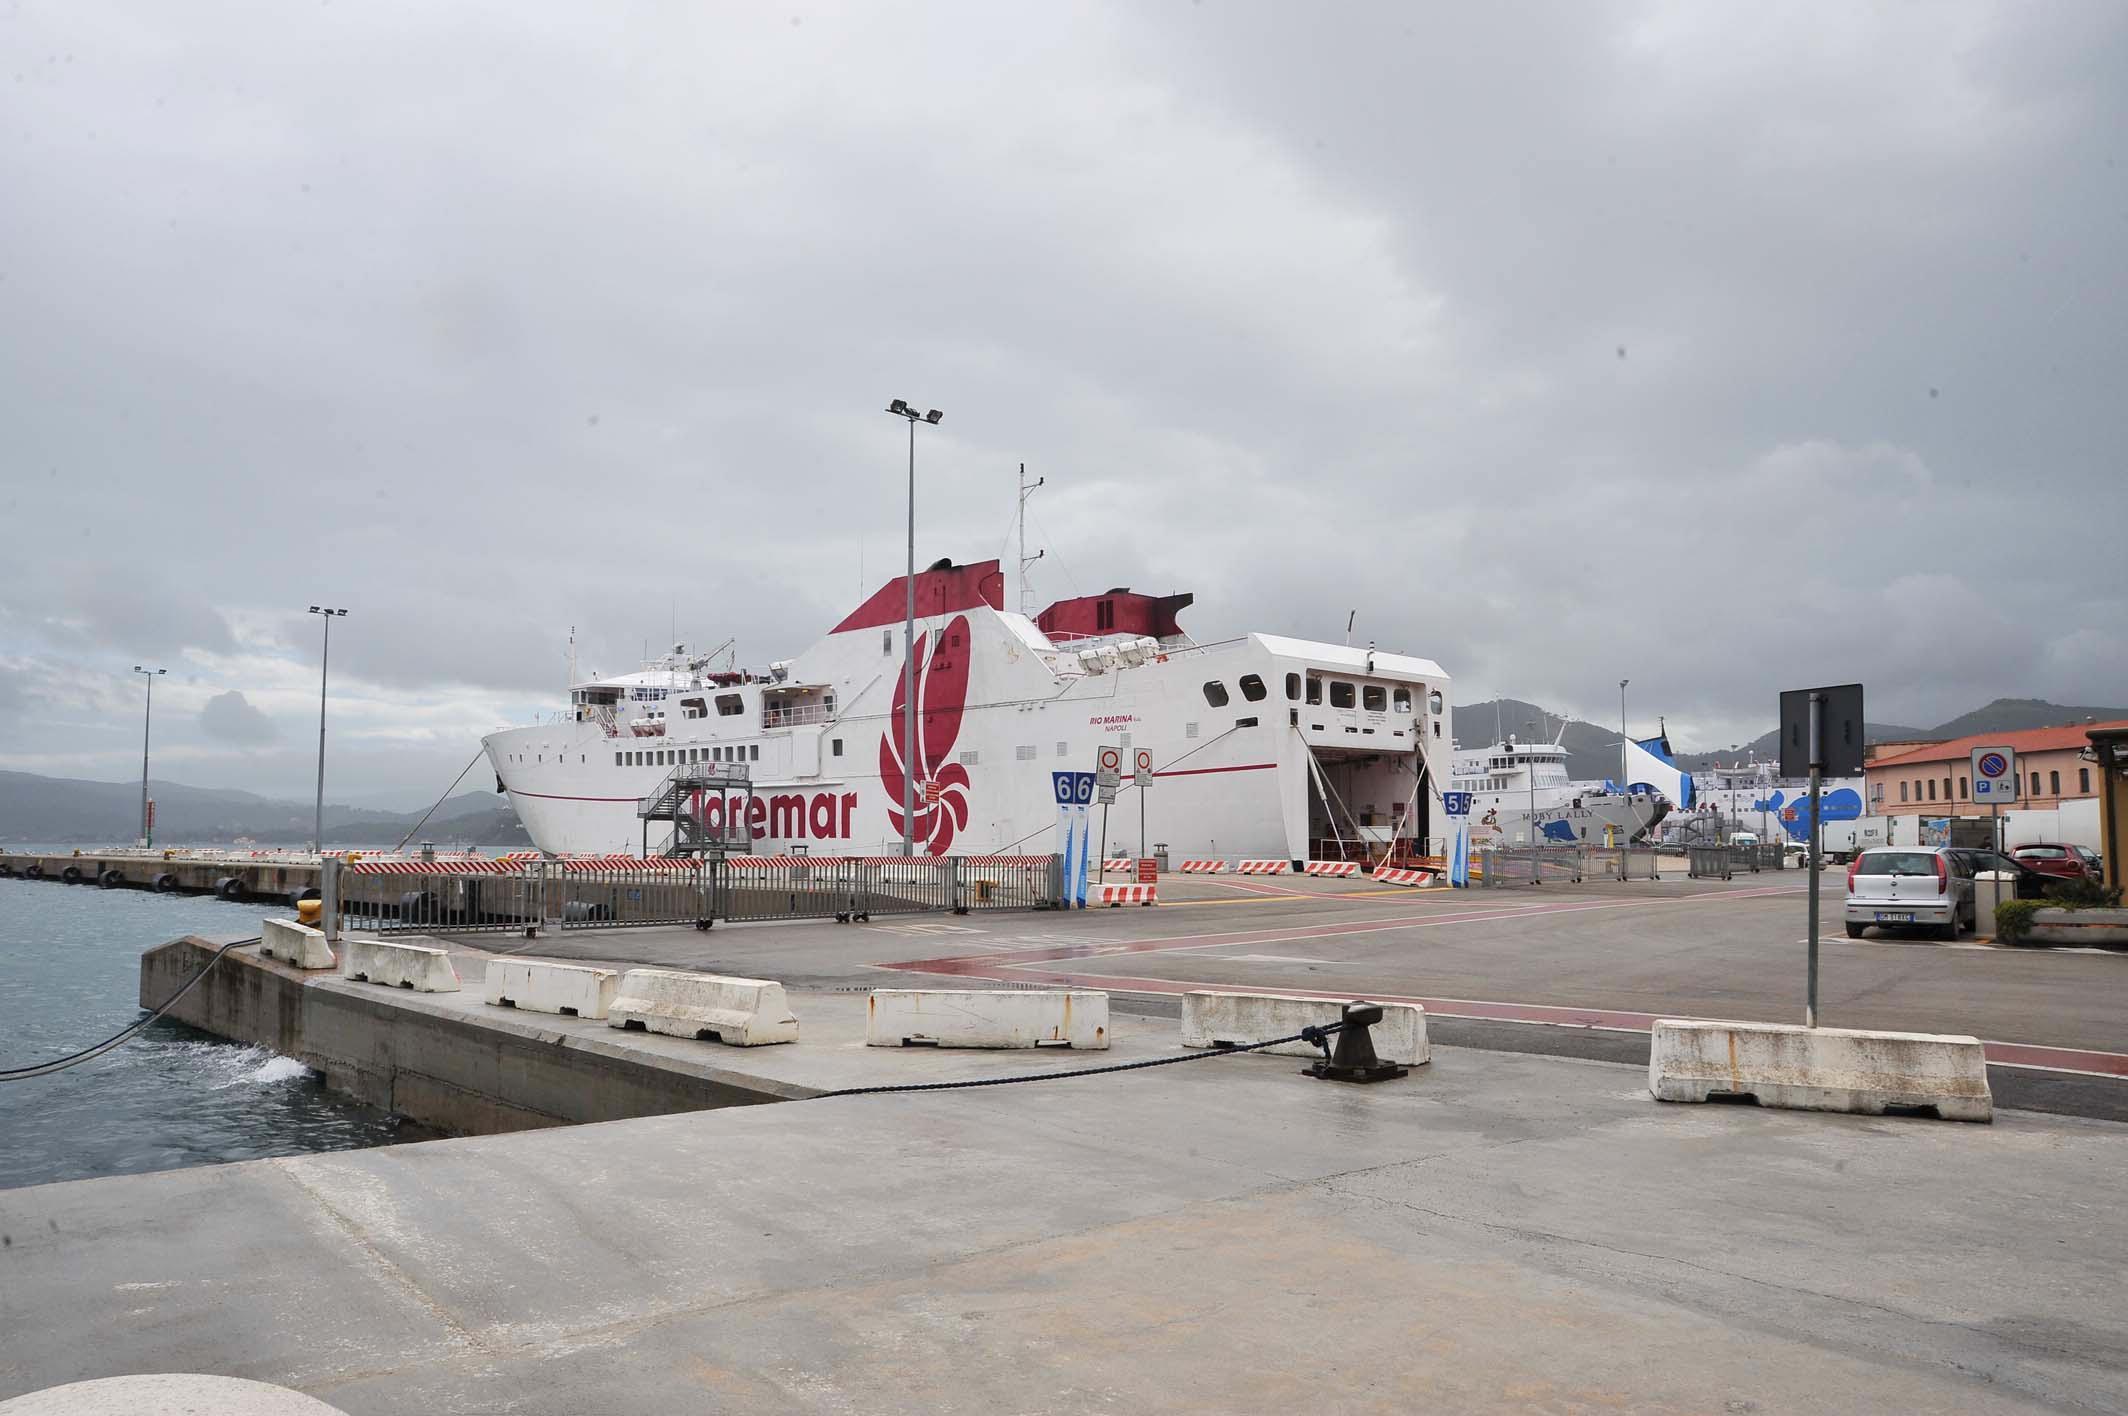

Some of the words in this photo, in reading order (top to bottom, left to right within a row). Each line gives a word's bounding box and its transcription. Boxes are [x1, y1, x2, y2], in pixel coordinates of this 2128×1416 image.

[1089, 717, 1103, 725] RIO
[1103, 714, 1133, 724] MARINA
[1105, 724, 1128, 732] NAPOLI
[1057, 775, 1072, 800] 6
[1077, 776, 1091, 800] 6
[1978, 782, 1988, 792] P
[1448, 795, 1459, 812] 5
[1463, 795, 1470, 812] 5
[1522, 811, 1553, 821] MOBY
[1557, 809, 1594, 819] LALLY
